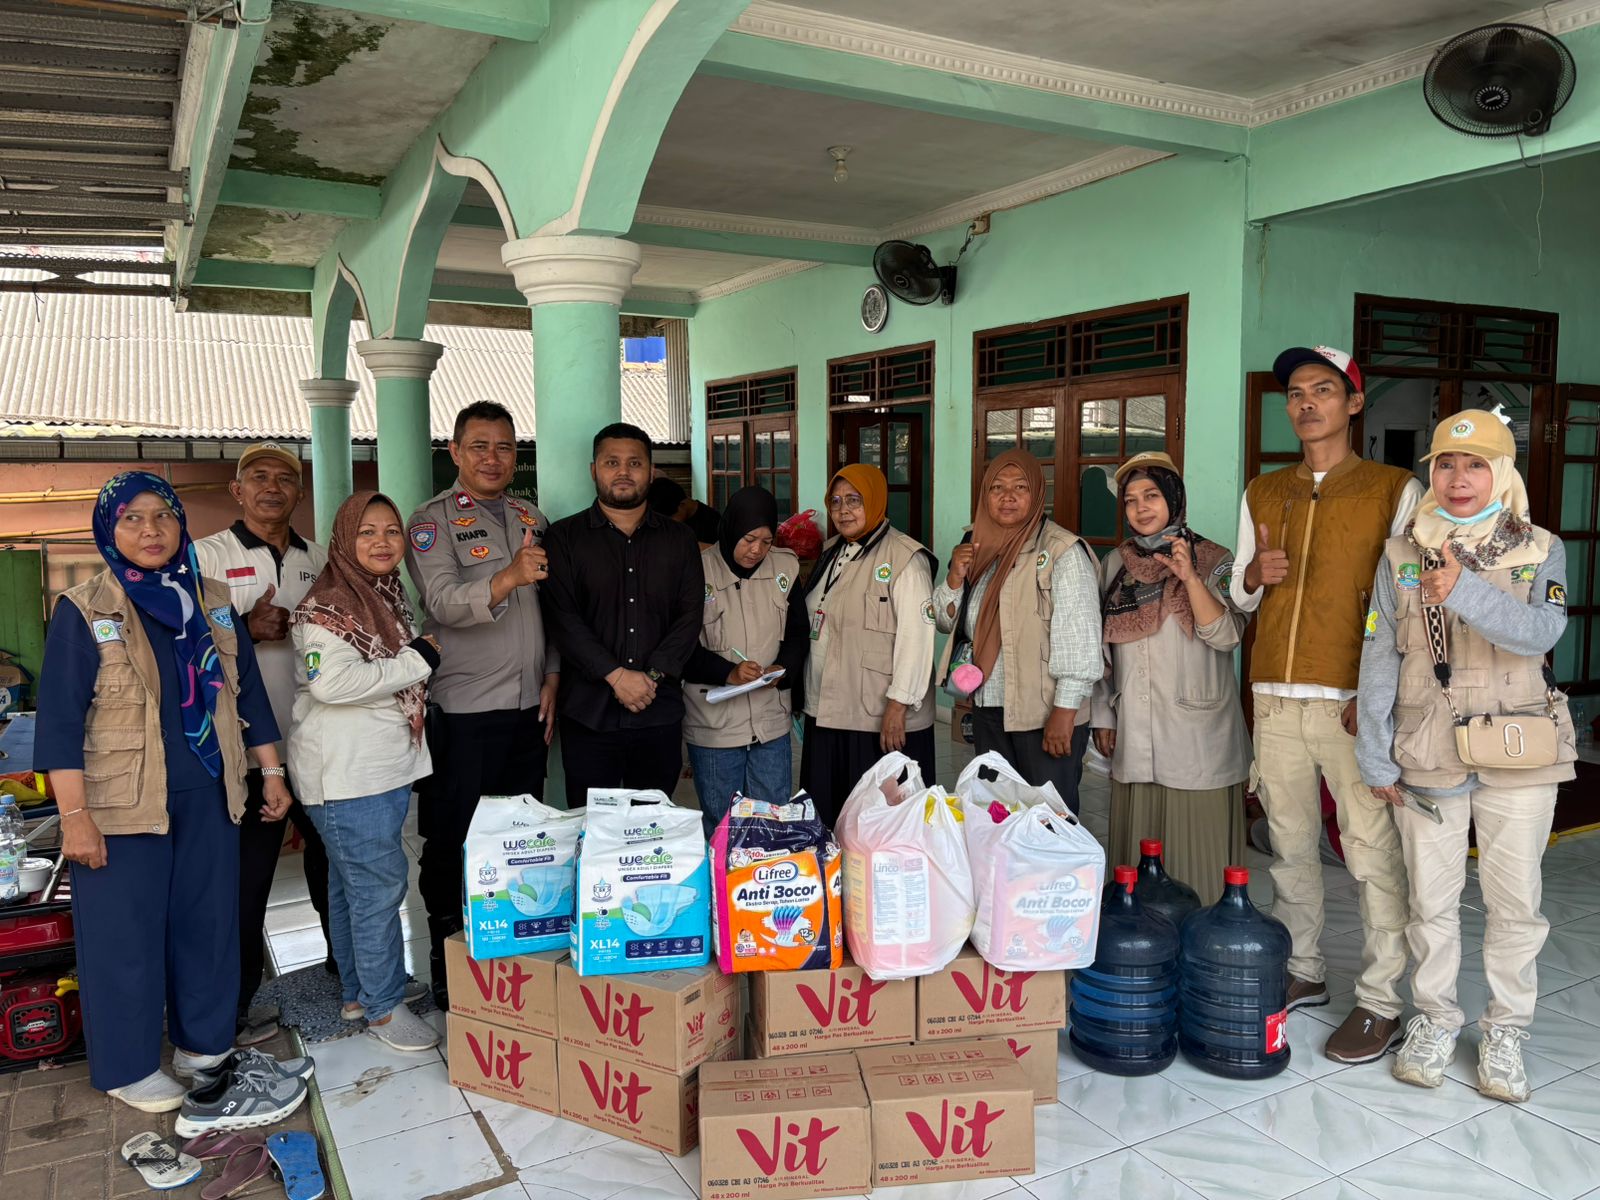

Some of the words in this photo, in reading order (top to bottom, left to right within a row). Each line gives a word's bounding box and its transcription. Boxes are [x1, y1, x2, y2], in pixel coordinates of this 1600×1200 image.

[456, 529, 488, 543] KHAFID
[503, 836, 557, 850] wecare
[510, 856, 543, 865] Comfortable
[618, 851, 673, 866] wecare
[758, 868, 791, 880] Lifree
[737, 885, 770, 901] Anti
[1016, 895, 1050, 909] Anti
[1051, 896, 1093, 909] Bocor
[478, 919, 508, 931] XL14
[590, 938, 620, 950] XL14
[466, 955, 533, 1012] Vit
[951, 962, 1037, 1014] Vit
[796, 971, 889, 1028] Vit
[579, 982, 654, 1047] Vit
[996, 1015, 1026, 1023] Berkualitas
[573, 1039, 584, 1047] 200
[814, 1033, 831, 1041] Harga
[465, 1030, 532, 1089] Vit
[578, 1059, 653, 1125] Vit
[572, 1112, 583, 1120] 200
[905, 1099, 1005, 1159] Vit
[736, 1116, 840, 1176] Vit
[956, 1161, 990, 1169] Berkualitas
[707, 1179, 729, 1187] 060328
[790, 1179, 825, 1187] Berkualitas
